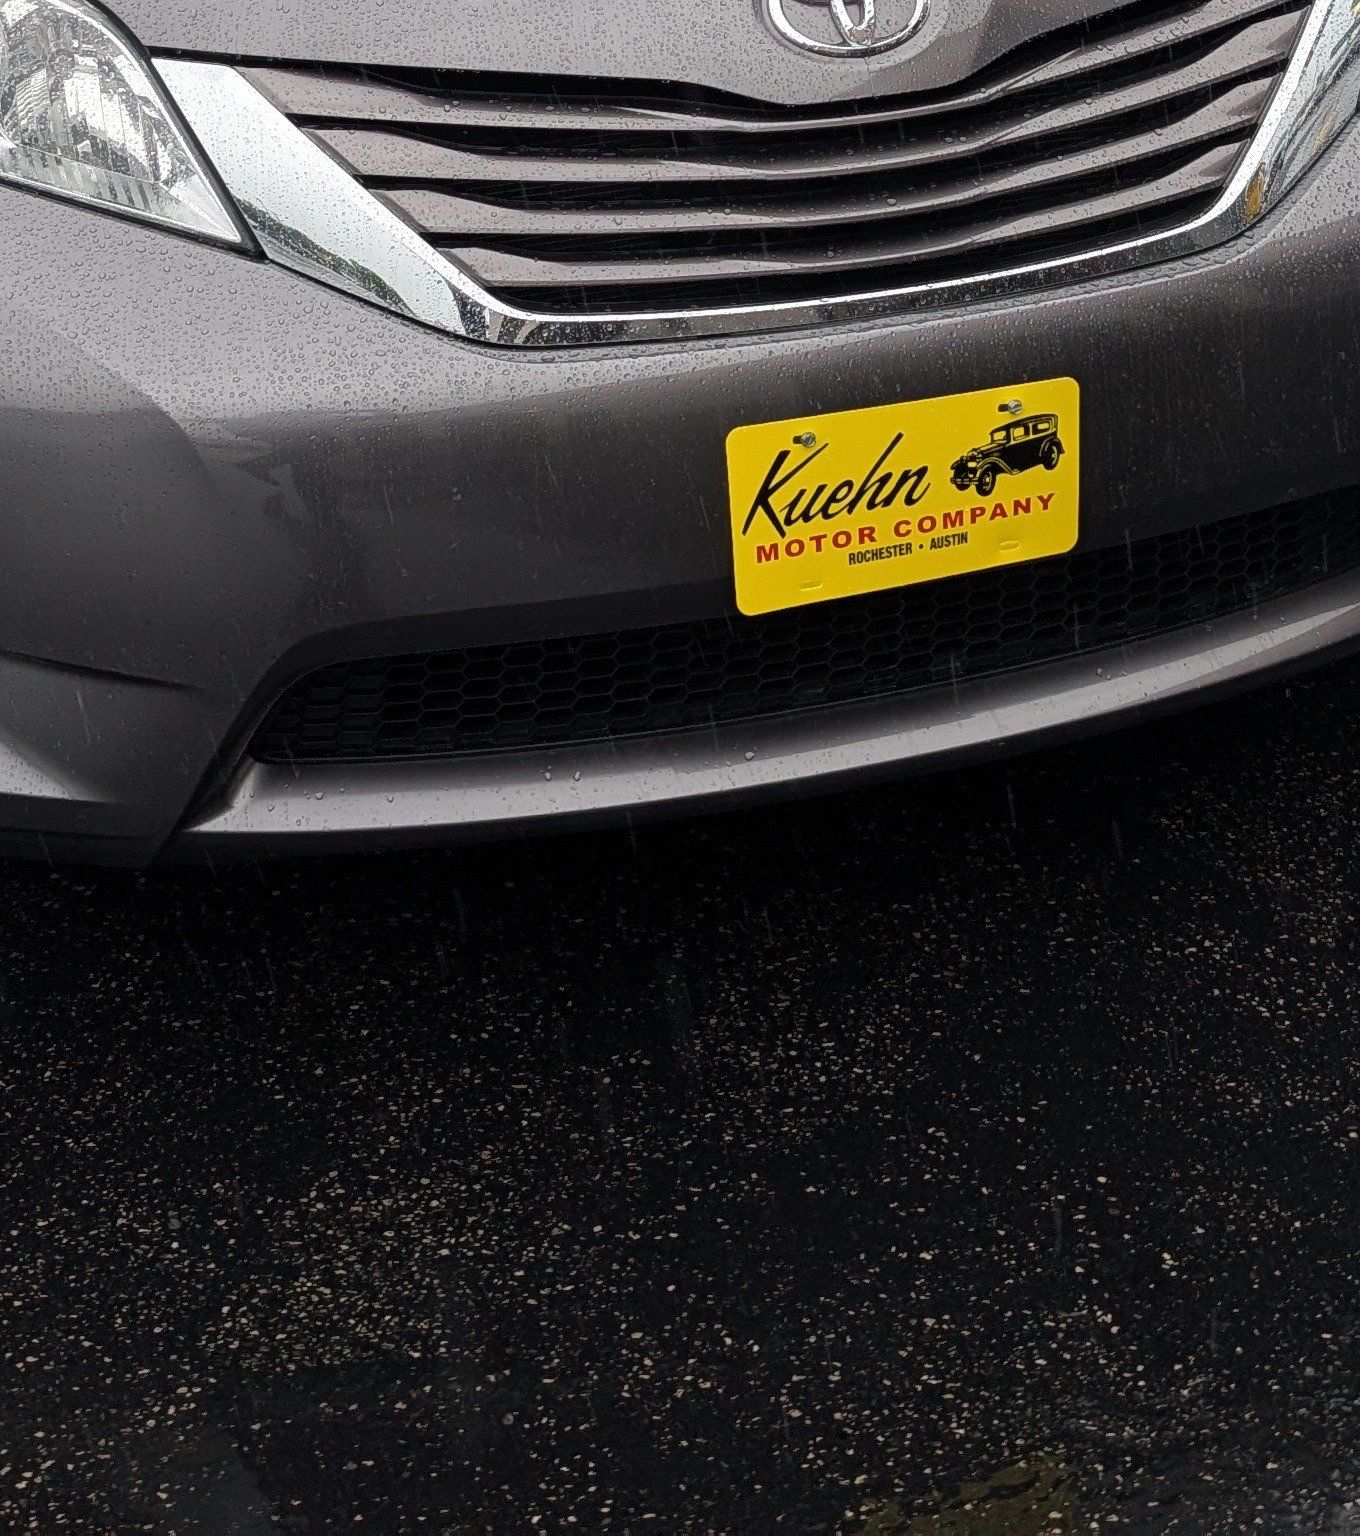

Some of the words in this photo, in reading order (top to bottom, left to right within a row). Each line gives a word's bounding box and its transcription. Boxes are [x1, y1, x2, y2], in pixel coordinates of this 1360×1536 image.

[742, 432, 931, 539] Kuehn
[755, 525, 878, 564] MOTOR
[893, 492, 1056, 538] COMPANY
[848, 542, 913, 566] ROCHESTER
[930, 531, 969, 552] AUSTIN
